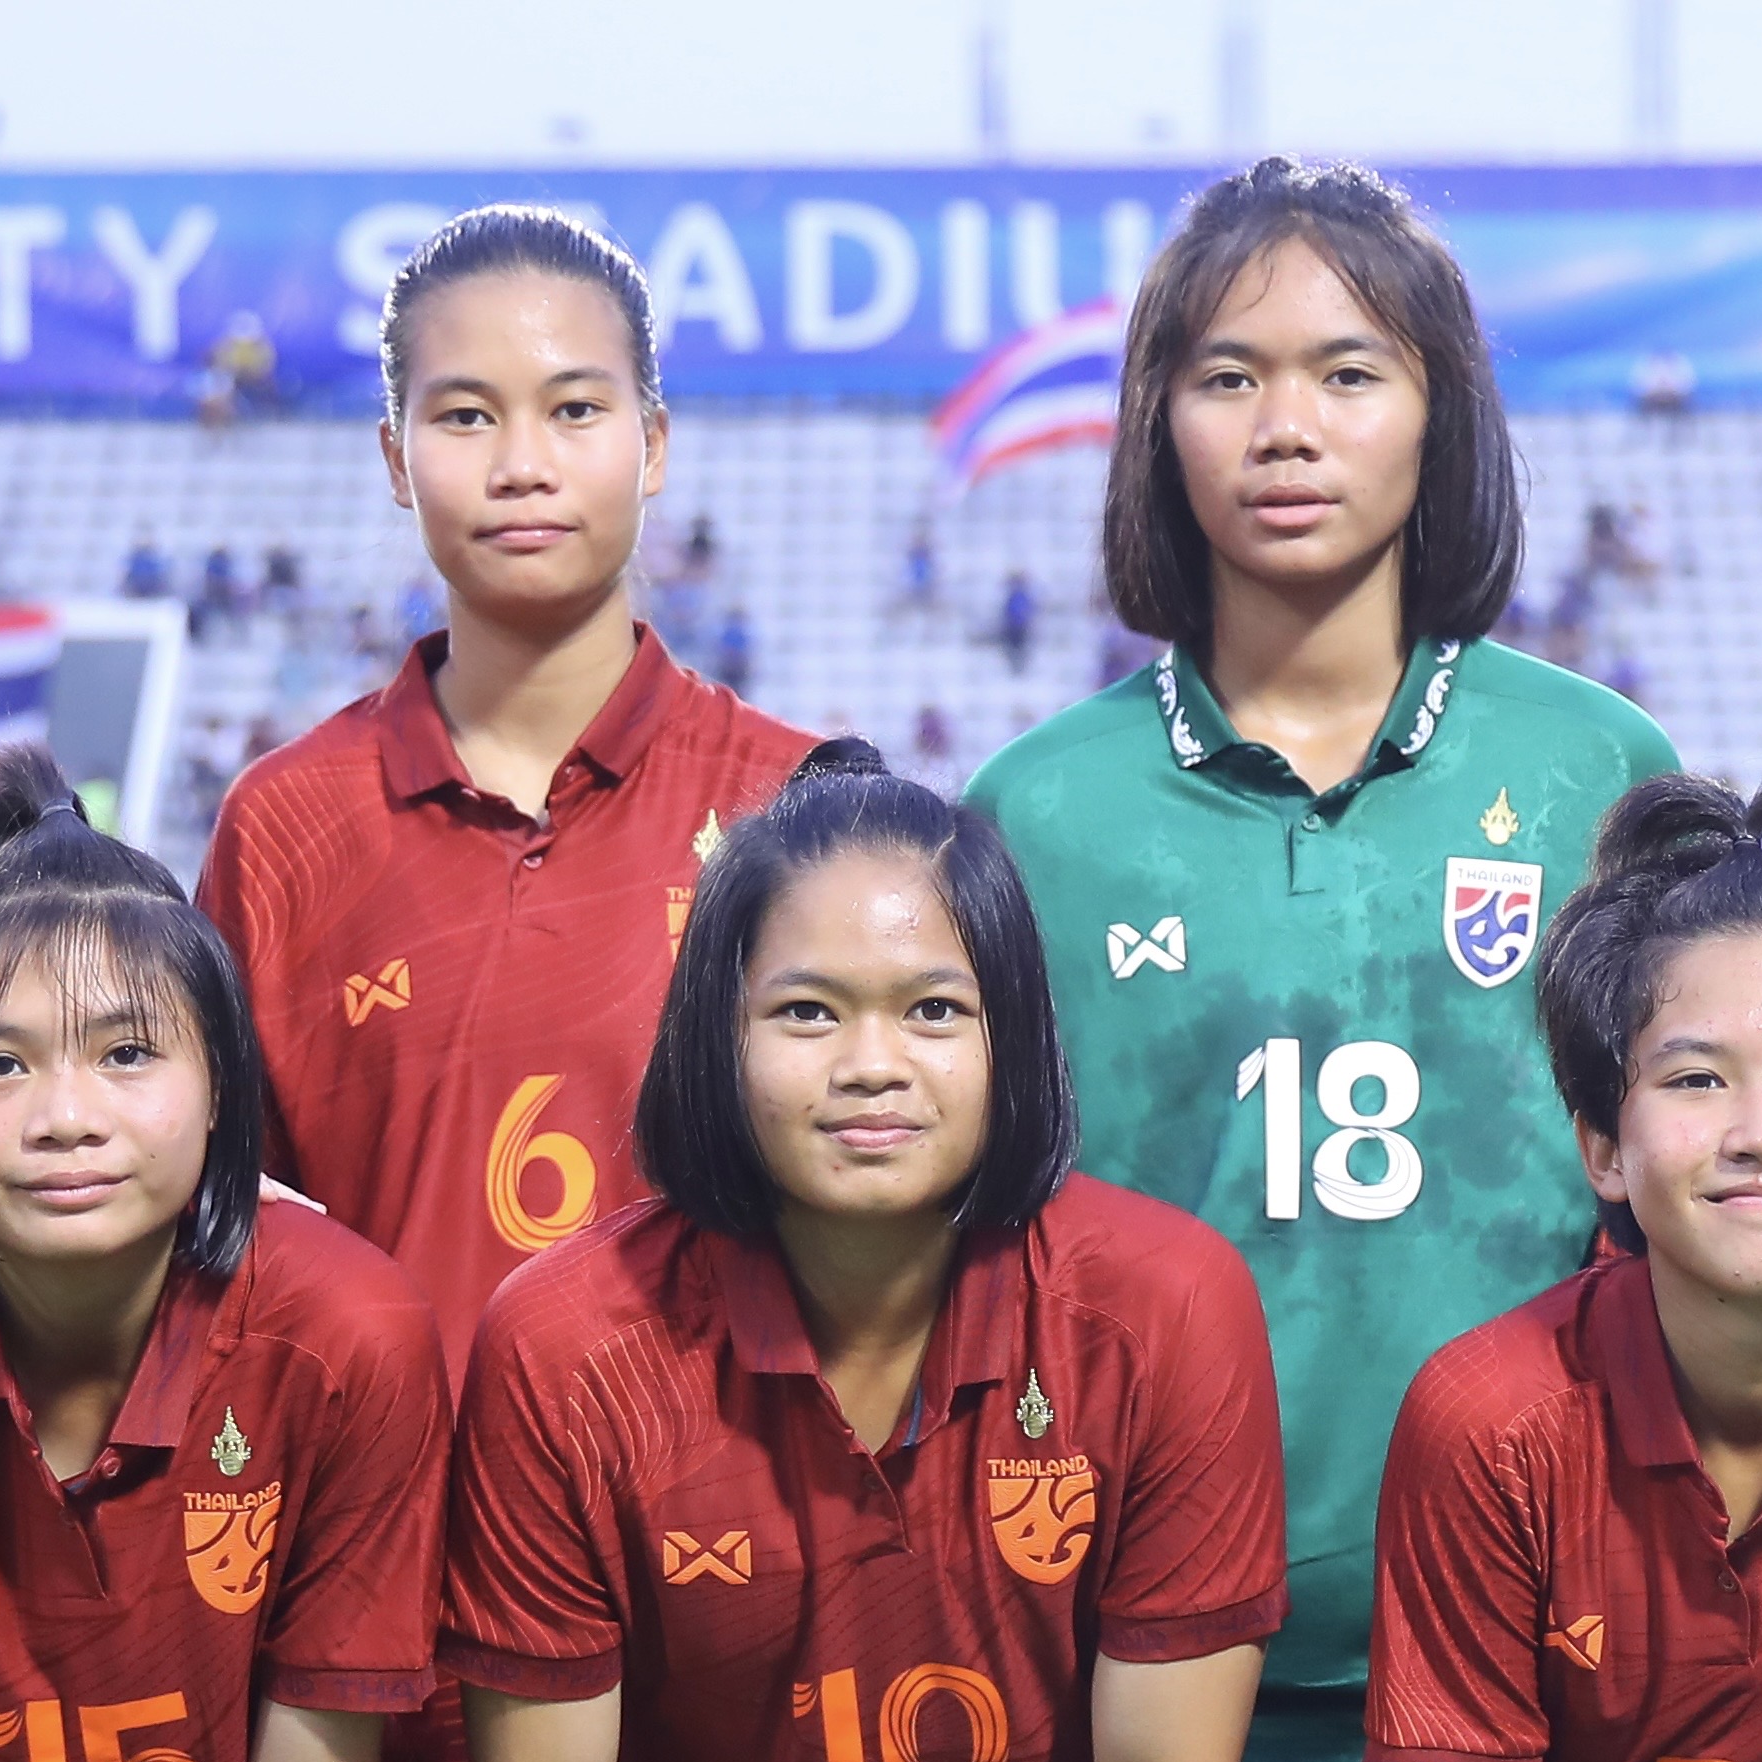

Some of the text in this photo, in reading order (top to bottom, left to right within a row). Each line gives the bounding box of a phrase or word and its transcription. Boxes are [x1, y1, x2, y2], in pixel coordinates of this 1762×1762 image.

[339, 198, 1154, 356] SADIU
[1458, 867, 1534, 887] THAILAND
[486, 1073, 598, 1253] 6
[1237, 1037, 1424, 1221] 18
[183, 1481, 282, 1510] THAILAND
[987, 1454, 1089, 1477] THAILAND
